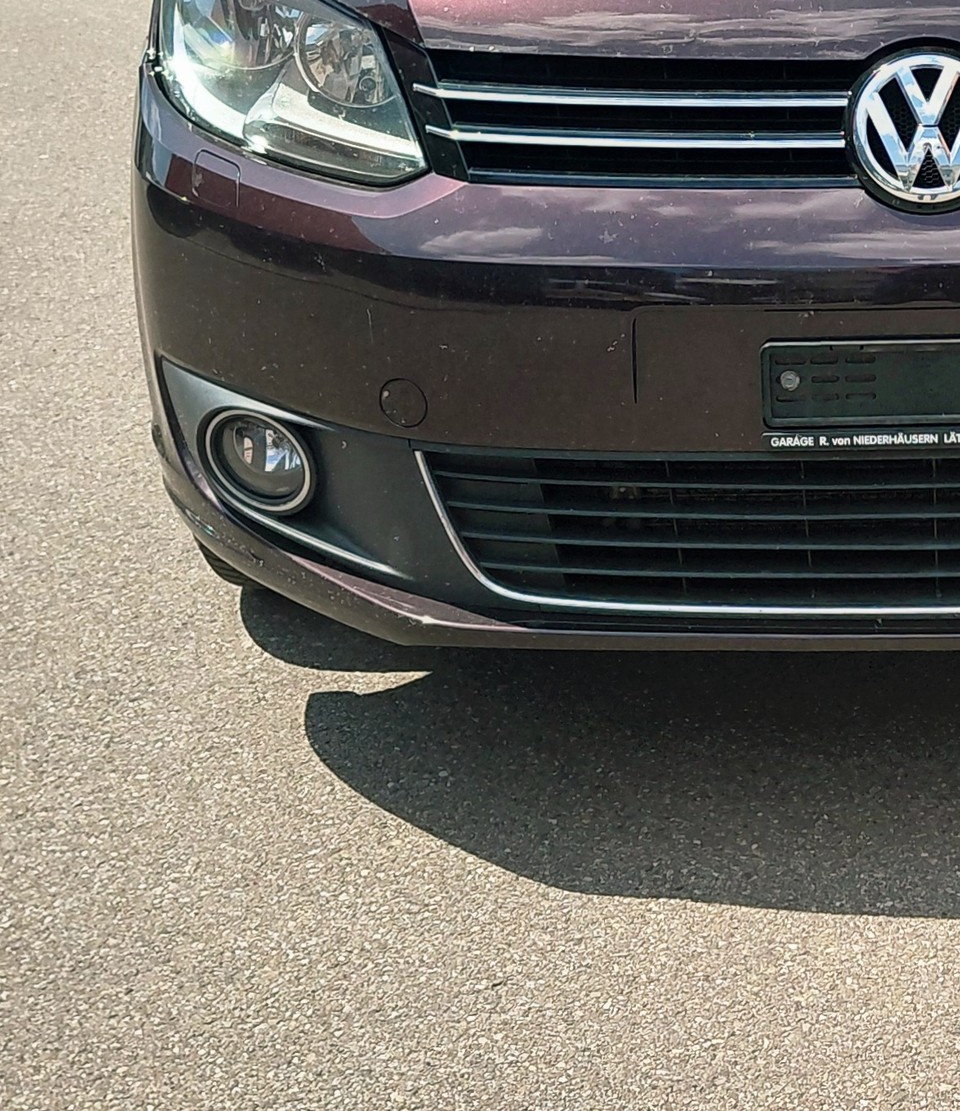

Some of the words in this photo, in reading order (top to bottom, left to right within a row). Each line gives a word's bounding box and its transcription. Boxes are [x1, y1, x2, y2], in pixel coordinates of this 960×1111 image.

[819, 436, 830, 446] R.
[831, 437, 851, 446] von
[853, 432, 939, 445] NIEDERHÄUSERN
